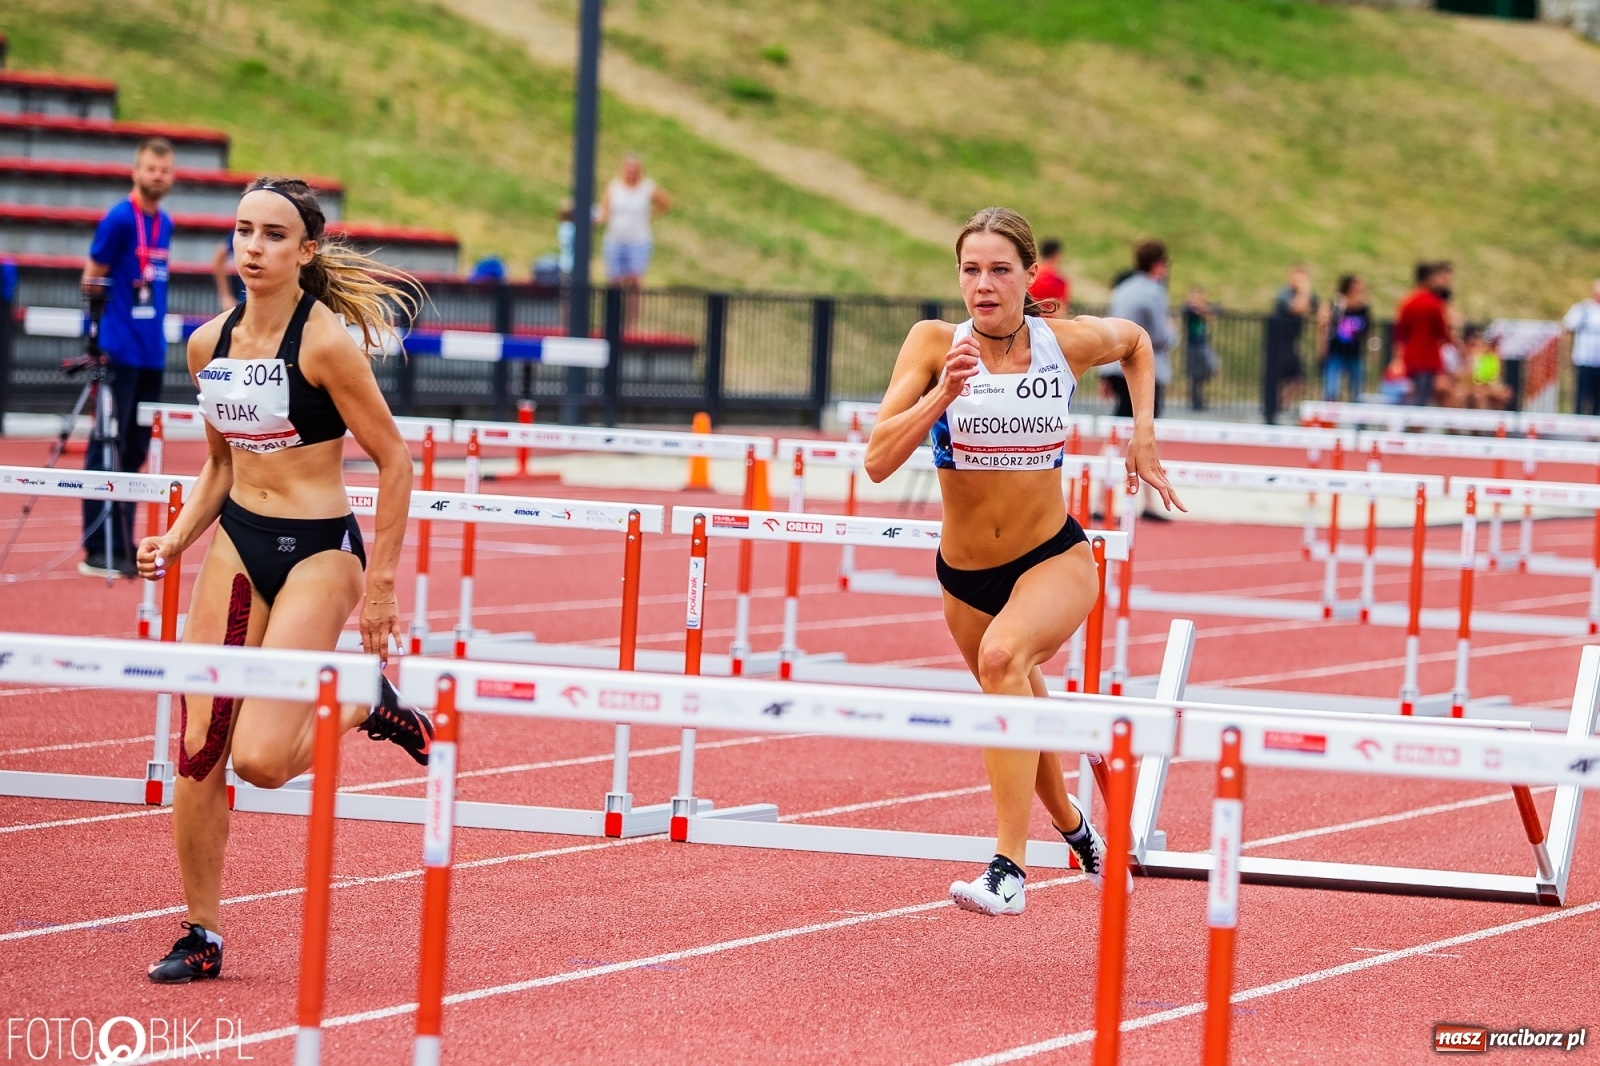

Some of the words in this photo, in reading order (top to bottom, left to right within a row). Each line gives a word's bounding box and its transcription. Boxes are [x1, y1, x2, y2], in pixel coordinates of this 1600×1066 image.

[243, 364, 283, 386] 304
[973, 387, 1005, 395] Racibórz
[1016, 377, 1062, 399] 601
[216, 403, 260, 422] FIJAK
[957, 416, 1063, 434] WESOŁOWSKA
[261, 440, 287, 451] 2019
[964, 454, 1023, 466] RACIBÓRZ
[1026, 454, 1051, 465] 2019
[348, 496, 372, 507] RLEN
[430, 500, 450, 511] 4F
[787, 522, 822, 533] ORLEN
[882, 527, 902, 538] 4F
[690, 576, 698, 615] polanik
